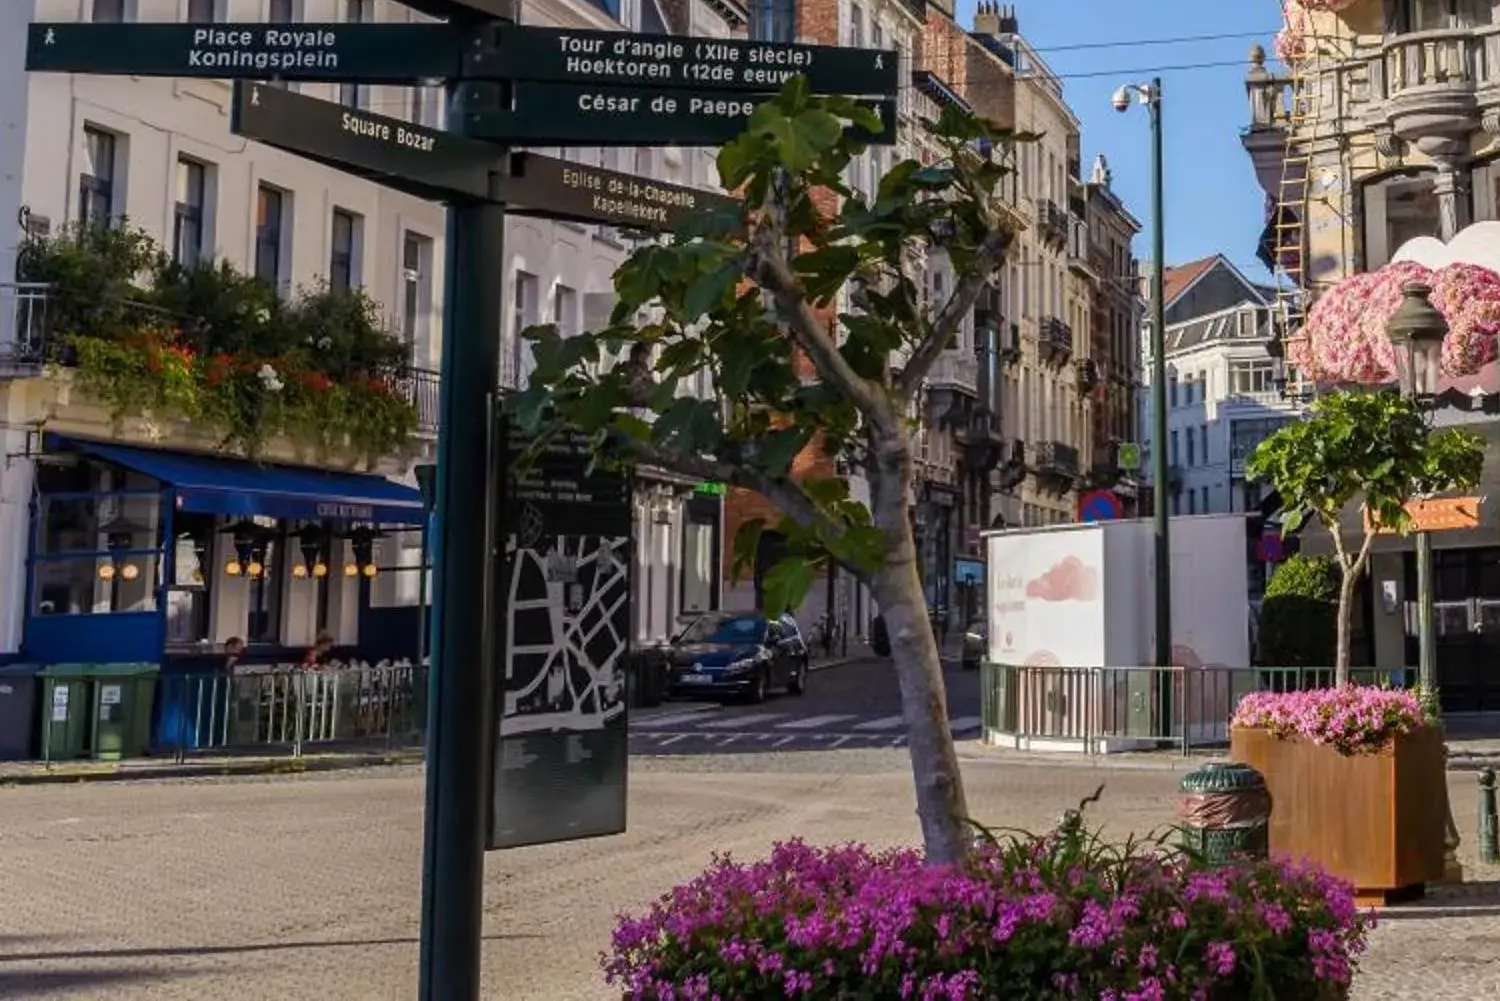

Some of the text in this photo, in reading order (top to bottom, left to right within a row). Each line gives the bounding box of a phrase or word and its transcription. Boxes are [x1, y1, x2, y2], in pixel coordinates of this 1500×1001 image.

[194, 29, 337, 50] Place Royale
[559, 36, 812, 66] Tour d'angle (XIIe siècle)
[188, 50, 339, 69] Koningsplein
[566, 57, 801, 85] Hoektoren (12de eeuw
[579, 93, 754, 117] César de Paepe
[340, 112, 436, 152] Square Bozar
[562, 168, 602, 191] Eglise
[593, 195, 668, 223] Kapellekerk
